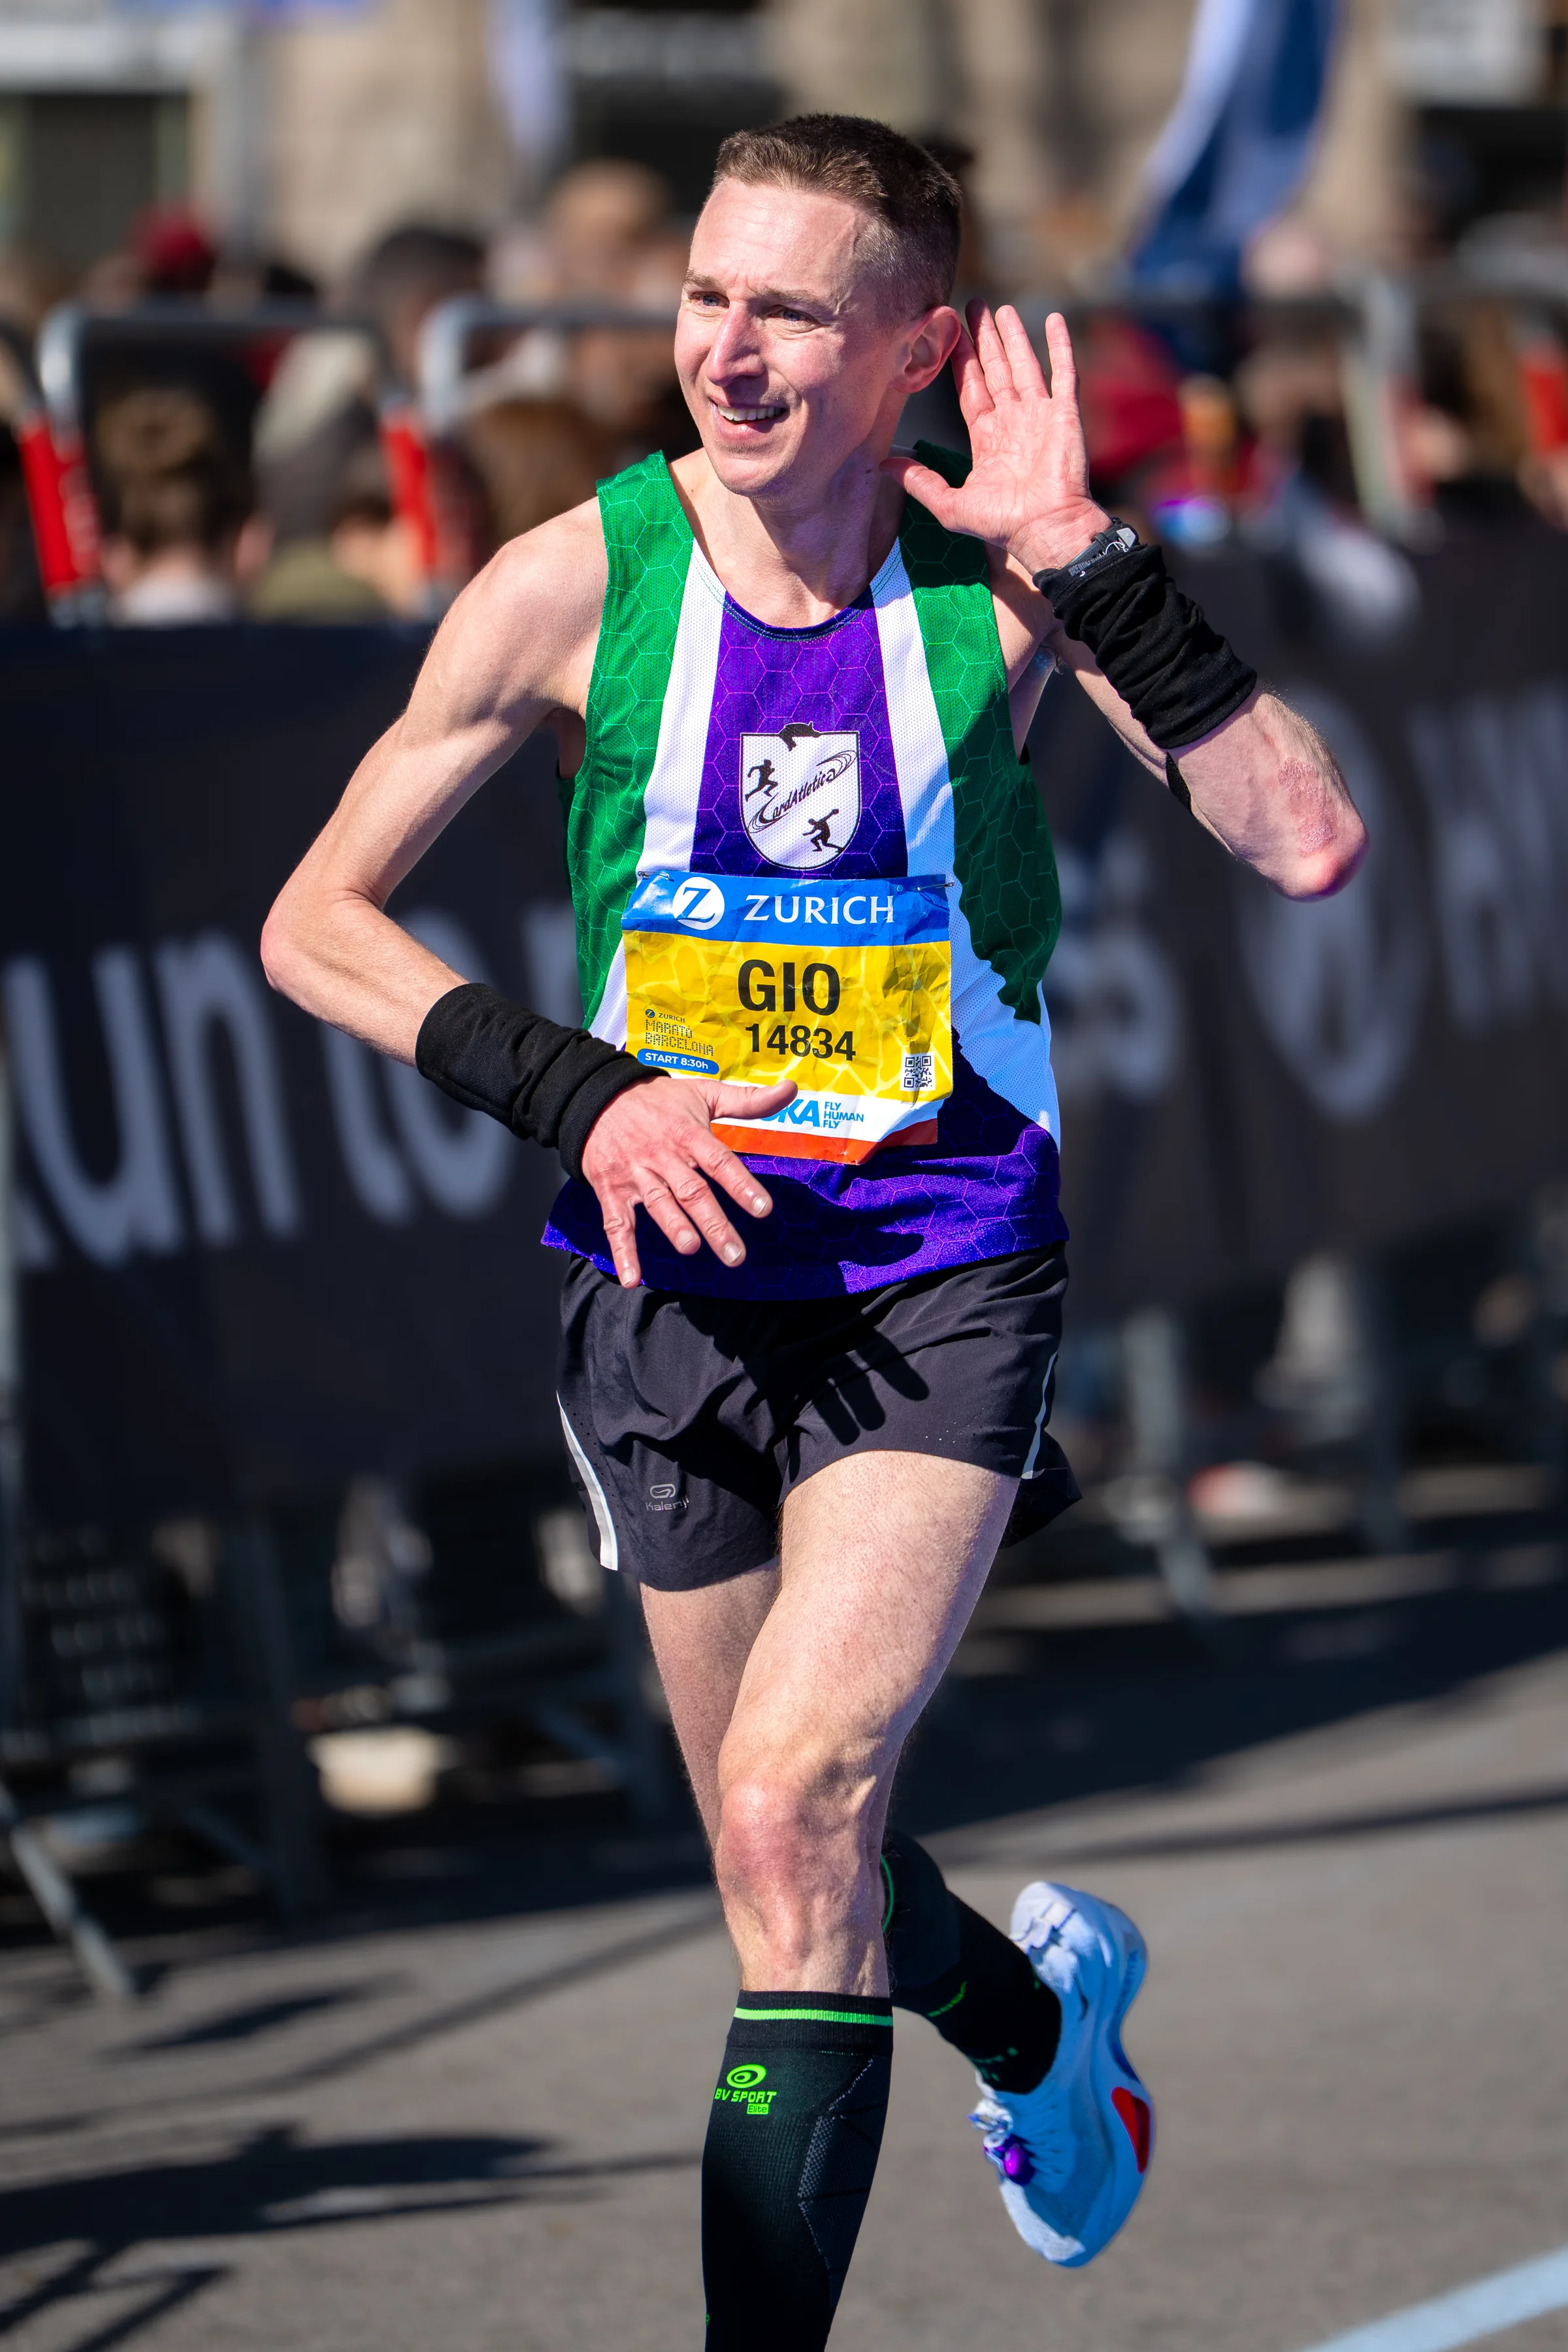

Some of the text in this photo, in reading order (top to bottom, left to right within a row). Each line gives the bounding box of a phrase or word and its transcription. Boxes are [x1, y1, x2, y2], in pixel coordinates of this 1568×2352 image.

[743, 895, 894, 925] ZURICH
[738, 959, 841, 1016] GIO
[659, 1012, 685, 1023] ZURICH
[645, 1032, 714, 1057] BARCELONA
[745, 1023, 857, 1062] 14834
[645, 1052, 709, 1070] START 8:30h
[1, 931, 301, 1269] un
[824, 1101, 841, 1111] FLY
[760, 1099, 821, 1127] KA
[823, 1110, 864, 1122] HUMAN
[823, 1120, 840, 1129] FLY
[714, 2087, 777, 2104] BV SPORT
[748, 2105, 768, 2113] Elite
